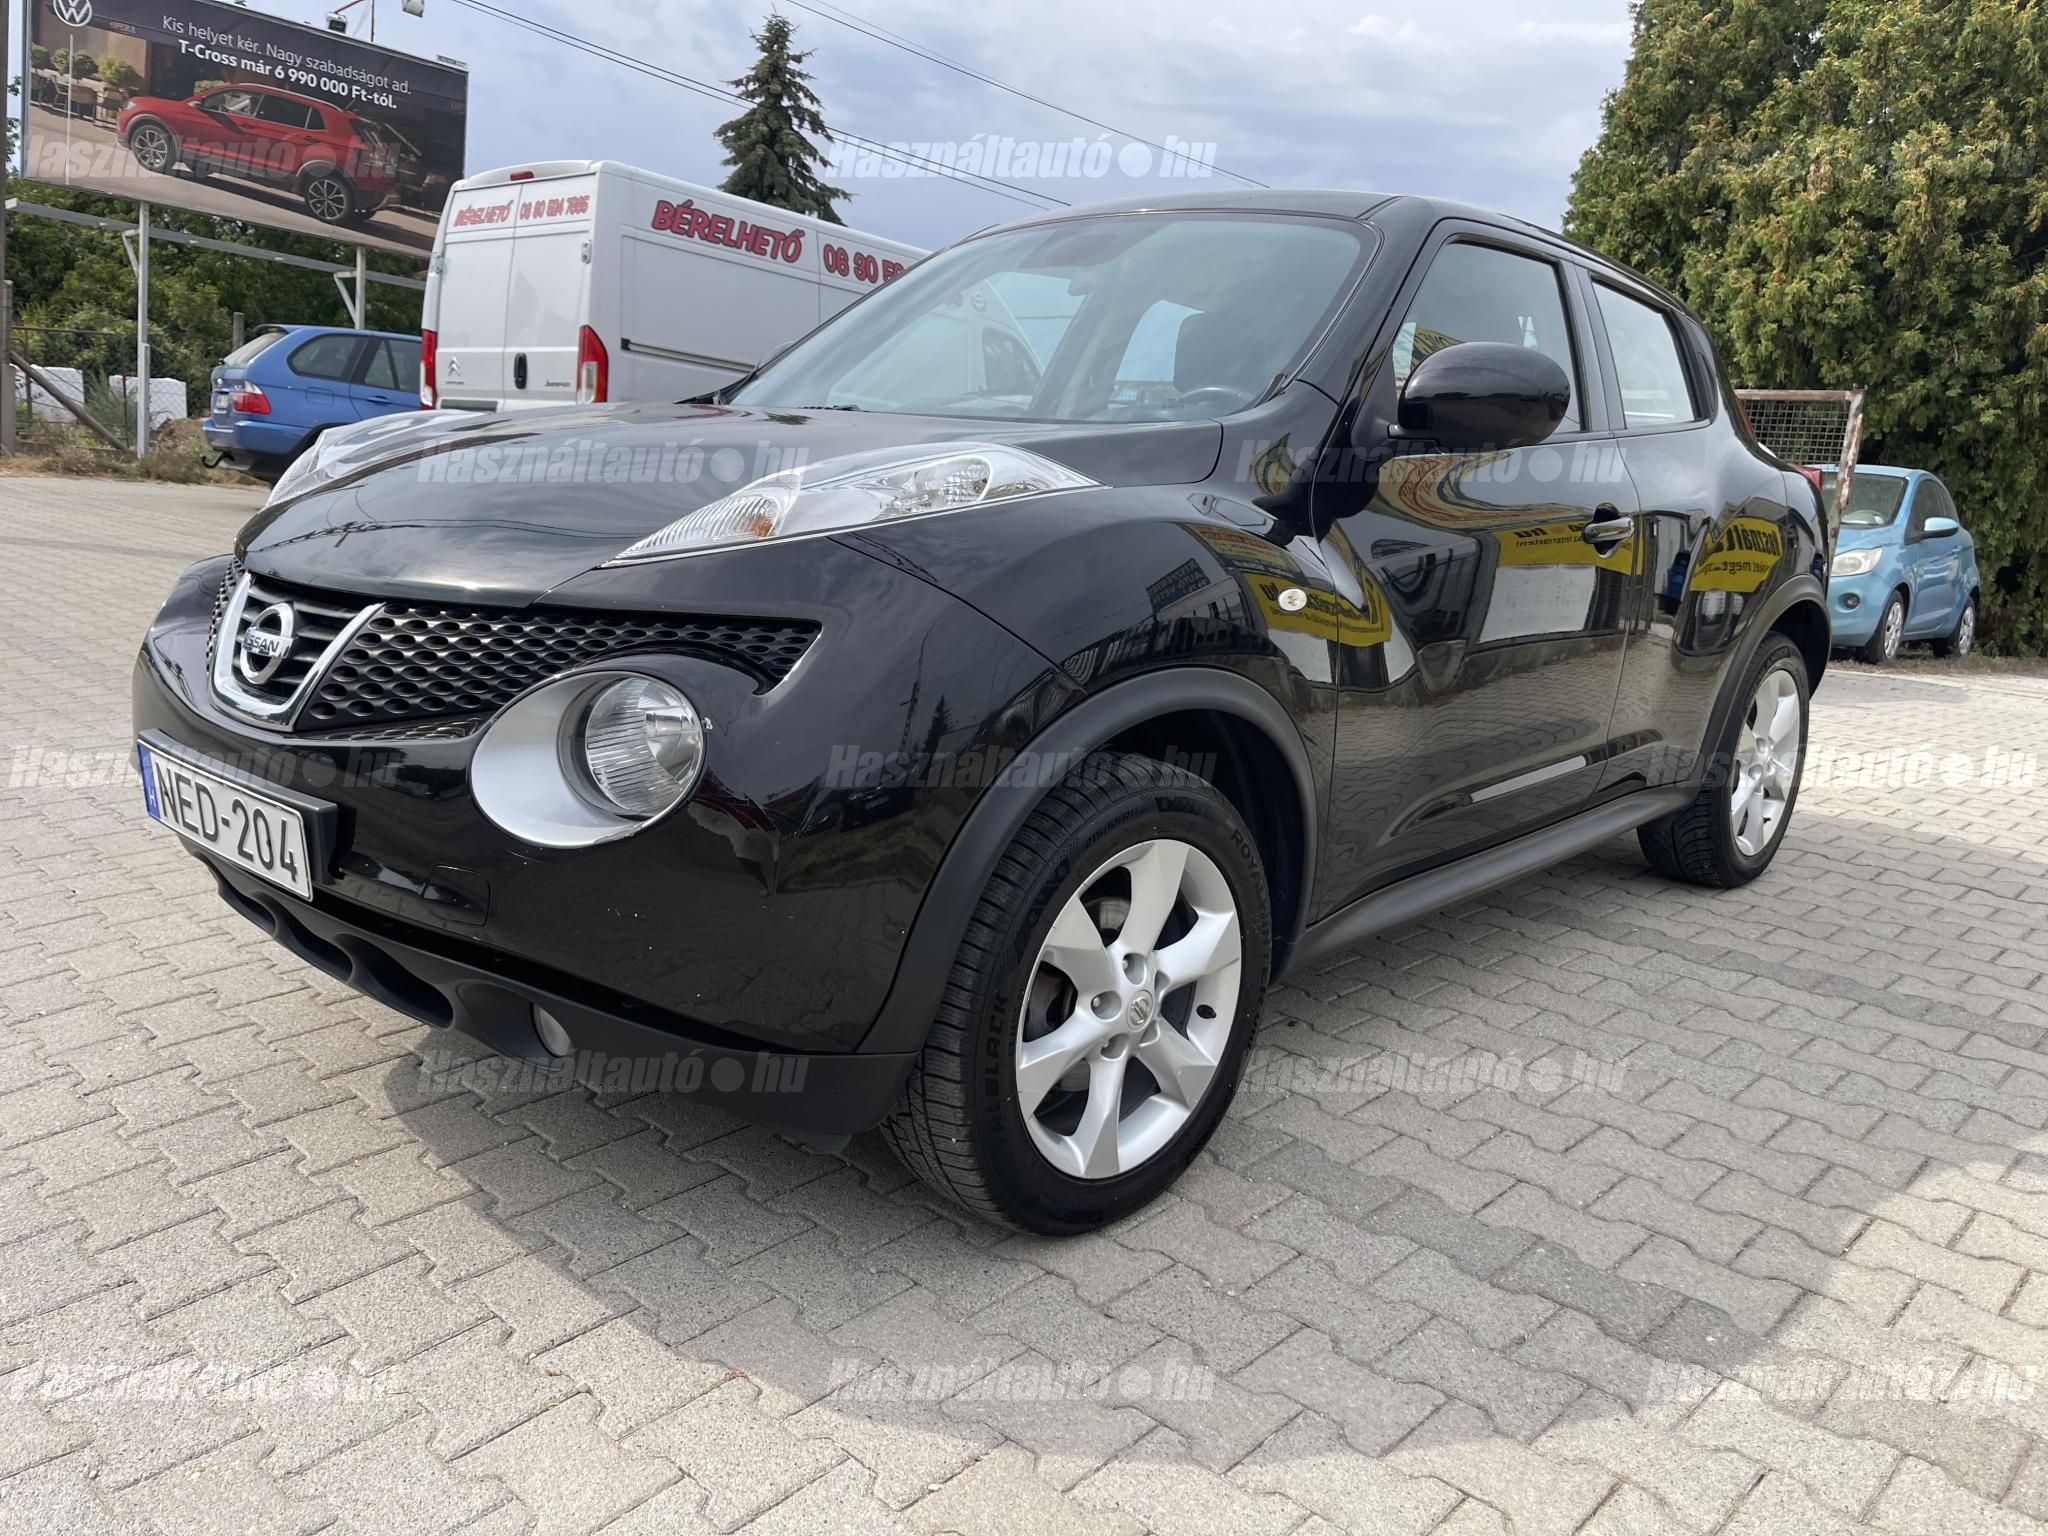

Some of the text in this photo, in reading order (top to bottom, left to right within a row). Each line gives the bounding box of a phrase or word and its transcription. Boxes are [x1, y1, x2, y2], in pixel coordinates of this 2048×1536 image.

[162, 15, 185, 34] Kis
[188, 22, 233, 47] helyet
[237, 34, 261, 54] kér.
[266, 43, 302, 67] Nagy
[305, 56, 389, 89] szabadságot
[392, 80, 412, 95] ad.
[178, 39, 398, 109] T-Cross már 6 990 000 Ft-tól.
[823, 243, 849, 277] 06
[853, 251, 879, 284] 30
[148, 786, 157, 809] H
[154, 760, 299, 884] NED-204
